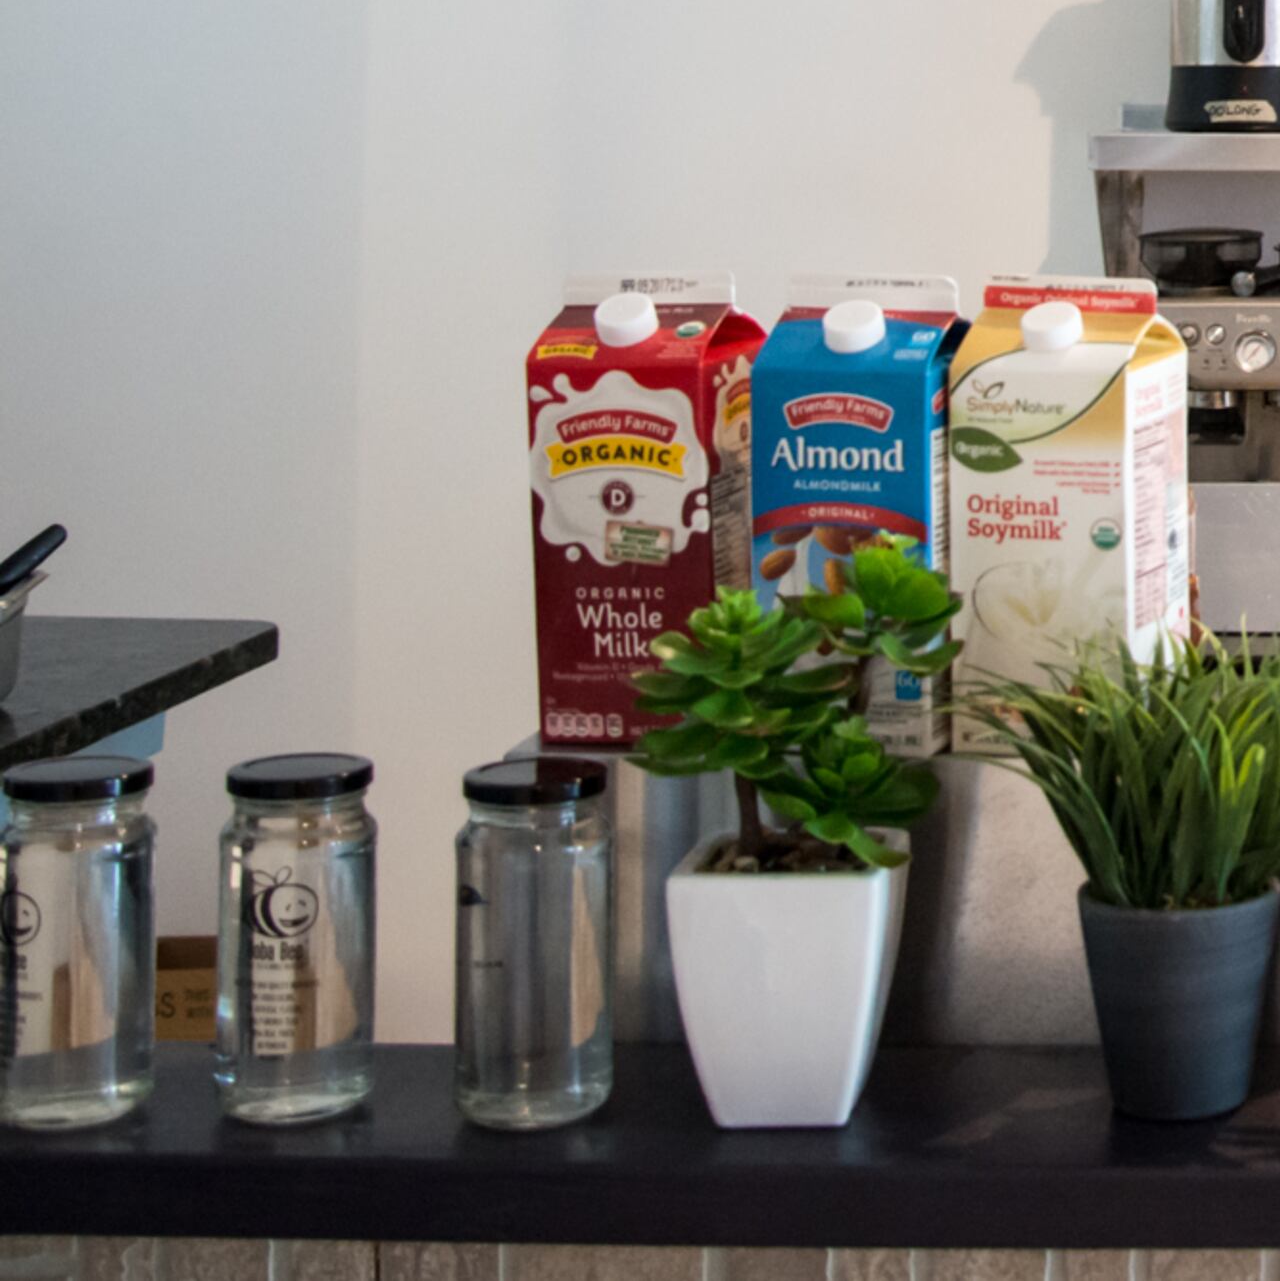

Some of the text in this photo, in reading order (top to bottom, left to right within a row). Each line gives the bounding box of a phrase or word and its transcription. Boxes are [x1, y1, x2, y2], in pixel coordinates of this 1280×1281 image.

[791, 400, 885, 419] Friendly Farms
[561, 415, 669, 438] Friendly Farms
[562, 443, 672, 466] ORGANIC
[771, 436, 904, 472] Almond
[955, 441, 1003, 458] Organic
[793, 478, 881, 492] ALMONDMILK
[610, 489, 626, 506] D
[967, 494, 1058, 520] Original
[808, 506, 869, 519] ORIGINAL
[967, 519, 1062, 544] Soymilk
[575, 587, 665, 600] ORGANIC
[576, 602, 663, 629] Whole
[594, 631, 650, 658] Milk
